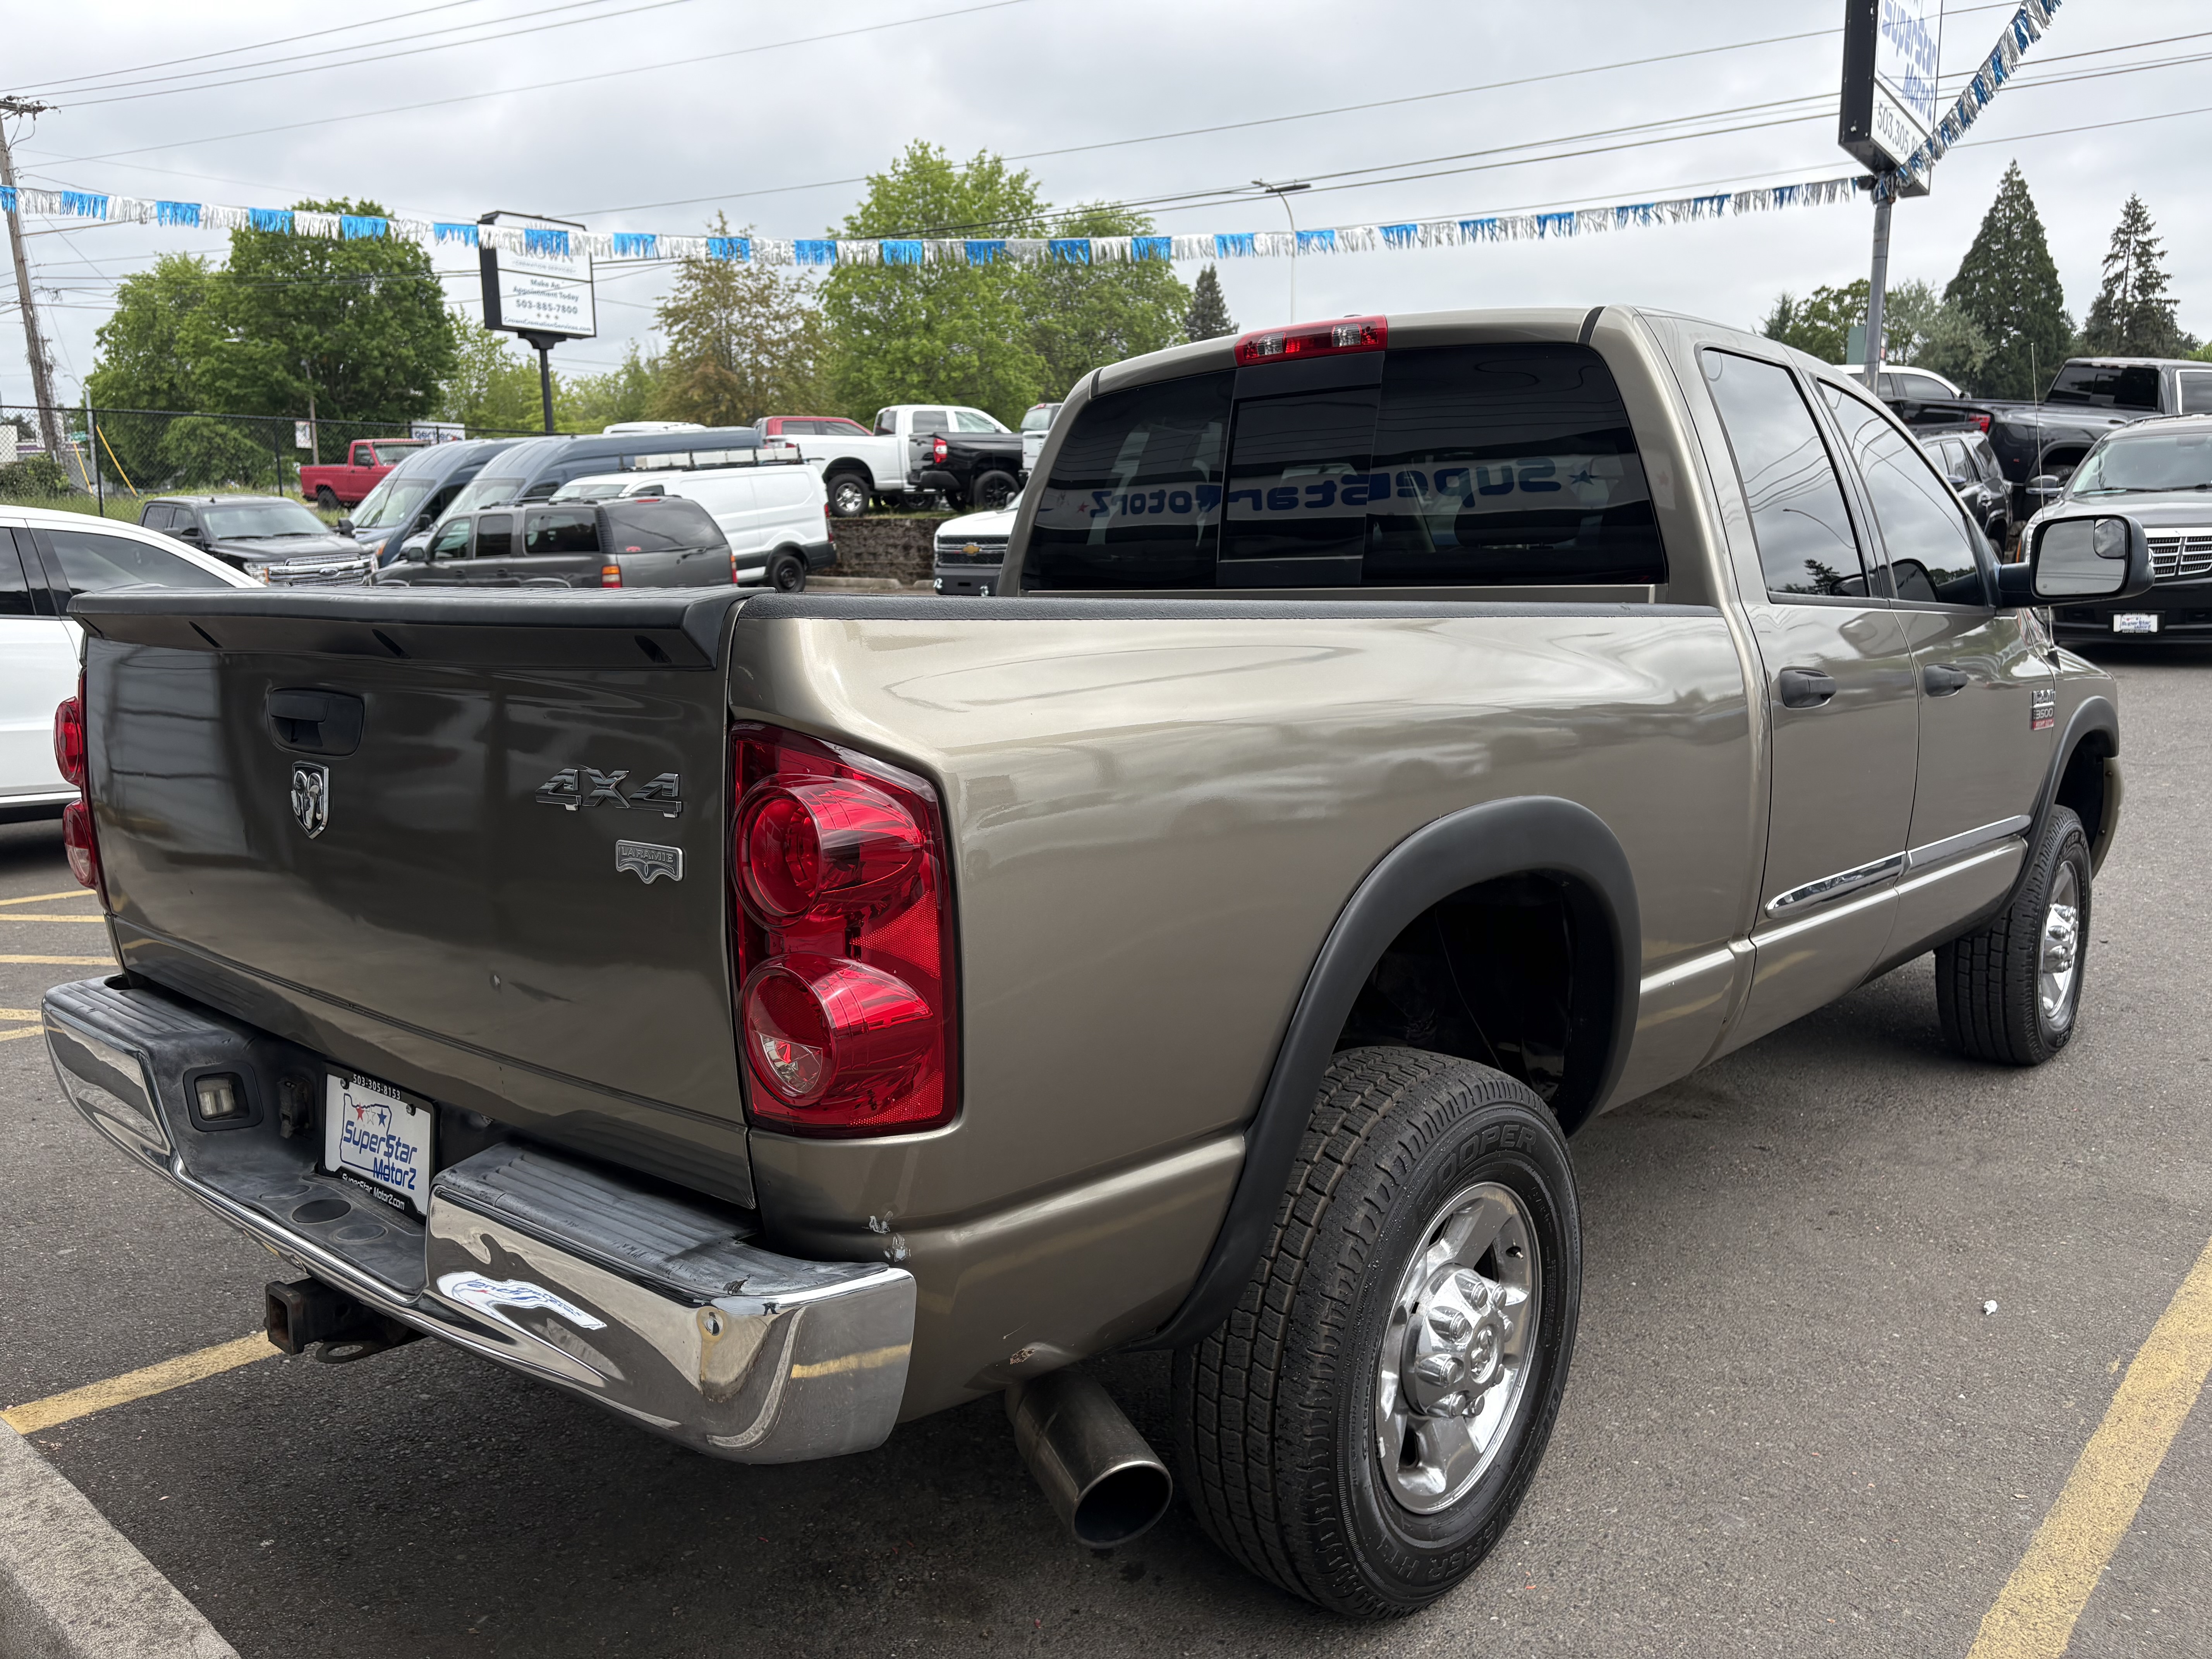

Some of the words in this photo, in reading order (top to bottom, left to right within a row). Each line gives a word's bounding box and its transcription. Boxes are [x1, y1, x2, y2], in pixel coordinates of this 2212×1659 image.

[1882, 0, 1936, 79] SuperStar
[1877, 101, 1920, 158] 503.305.8
[530, 278, 550, 287] Make
[559, 291, 579, 302] Today
[2035, 708, 2053, 720] 3500
[621, 847, 673, 862] LARAMIE
[353, 1073, 401, 1101] 503-305-8153
[343, 1120, 417, 1164] SuperStar
[1416, 1124, 1537, 1219] COOPER
